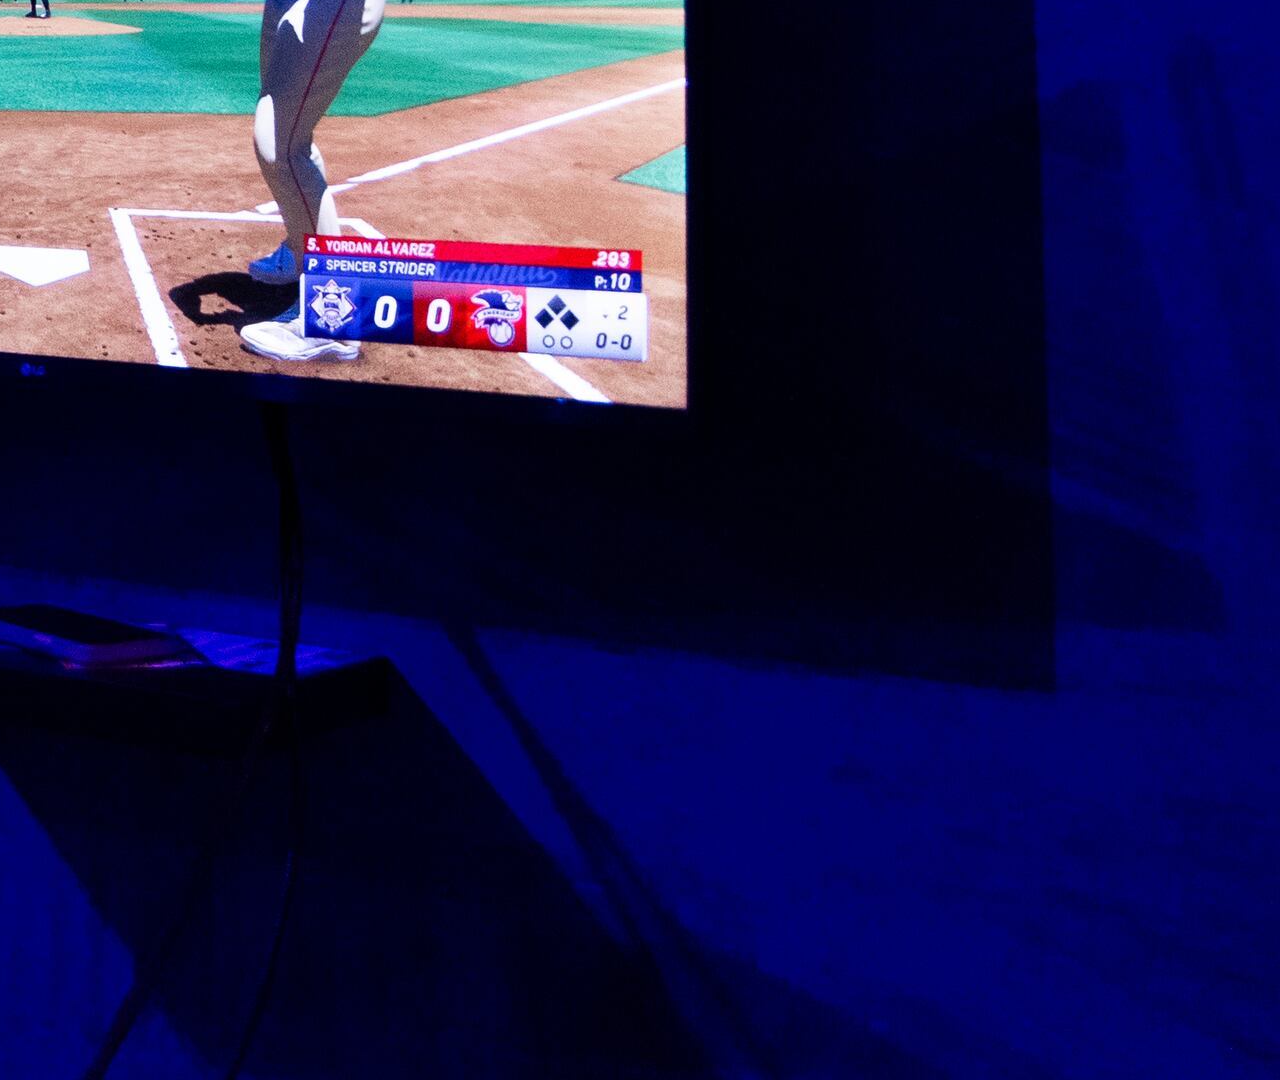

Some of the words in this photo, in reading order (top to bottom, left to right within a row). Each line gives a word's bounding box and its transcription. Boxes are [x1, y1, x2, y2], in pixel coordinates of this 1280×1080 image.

[325, 240, 372, 254] YORDAN
[373, 241, 436, 258] ALVAREZ
[308, 258, 318, 271] P
[326, 259, 376, 272] SPENCER
[378, 261, 436, 276] STRIDER
[373, 295, 398, 329] 0
[426, 298, 451, 332] 0
[618, 305, 628, 320] 2
[595, 332, 632, 351] 0-0
